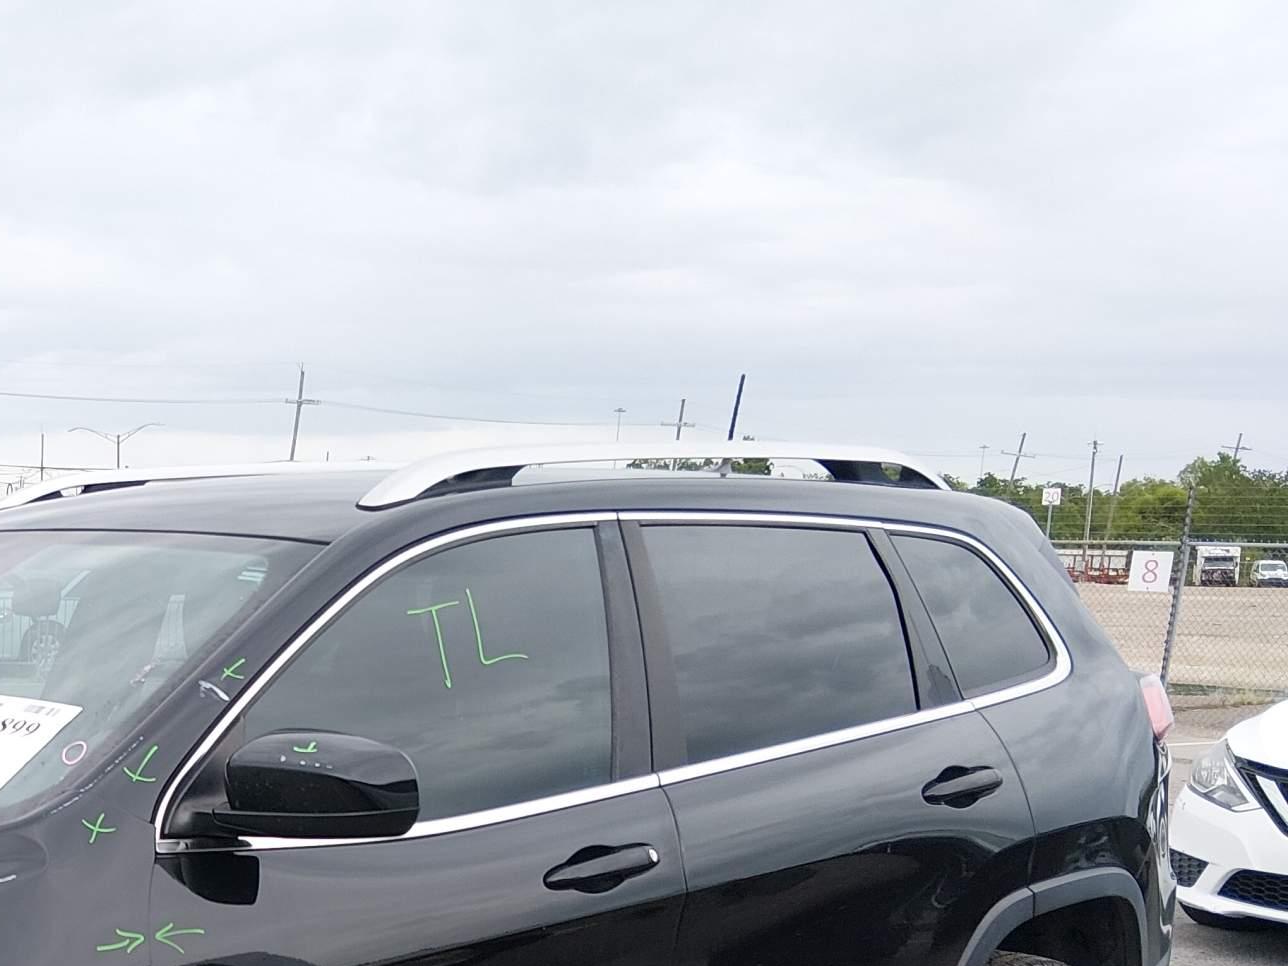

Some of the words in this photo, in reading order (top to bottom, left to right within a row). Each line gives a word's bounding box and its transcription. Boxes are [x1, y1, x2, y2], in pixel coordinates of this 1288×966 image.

[1044, 491, 1060, 502] 20
[1142, 559, 1159, 584] 8
[406, 587, 529, 689] TL
